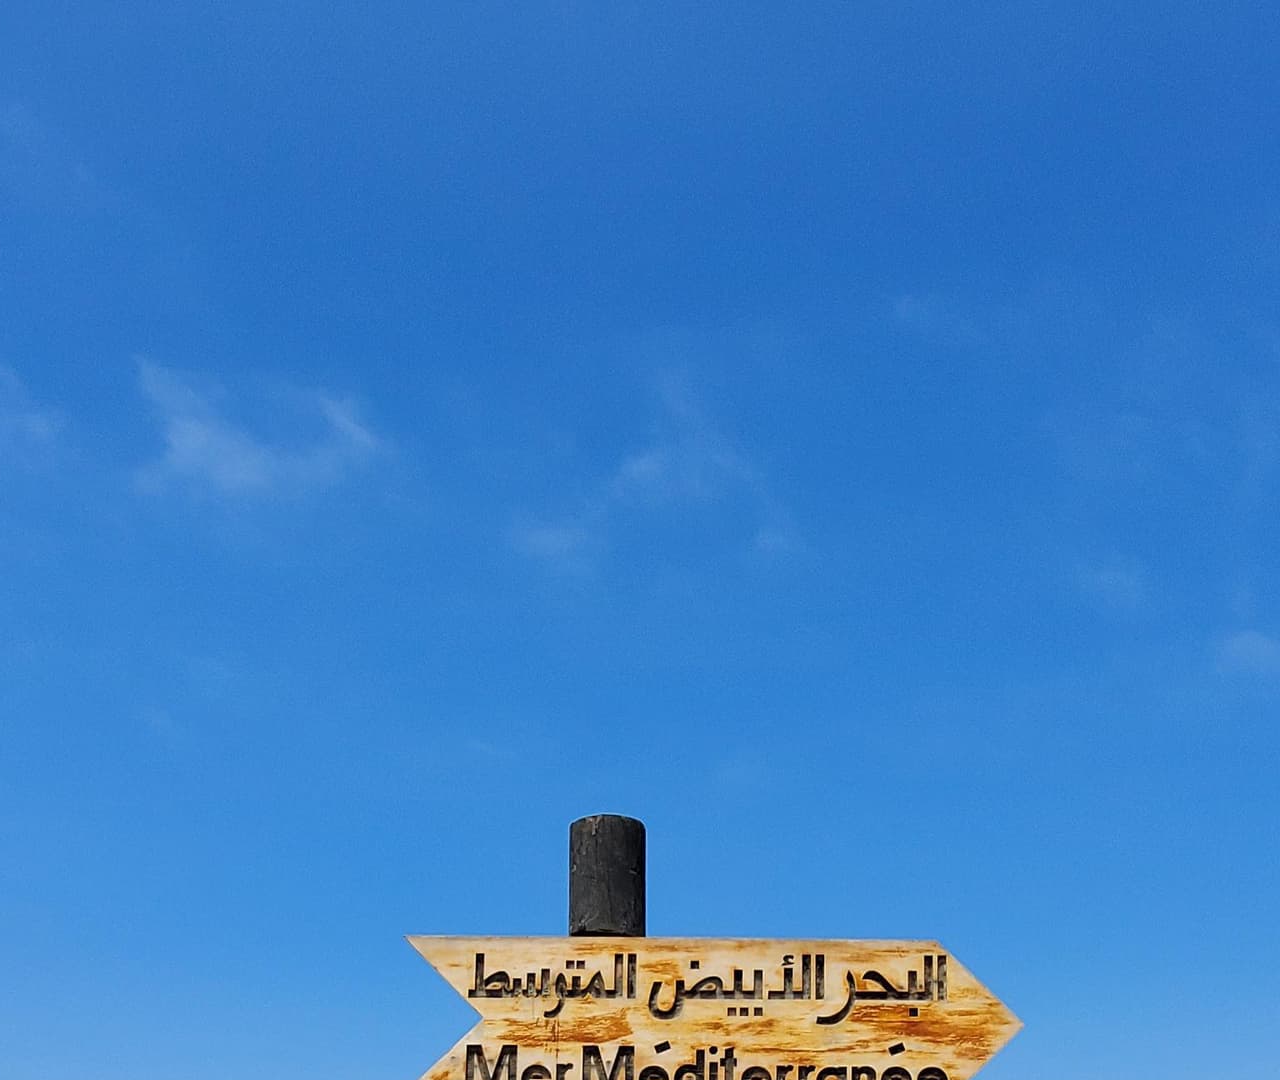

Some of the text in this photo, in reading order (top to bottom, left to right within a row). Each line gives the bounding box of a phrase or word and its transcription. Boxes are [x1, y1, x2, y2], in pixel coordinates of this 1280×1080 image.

[467, 952, 948, 1026] البحر الأبيض المتوسط
